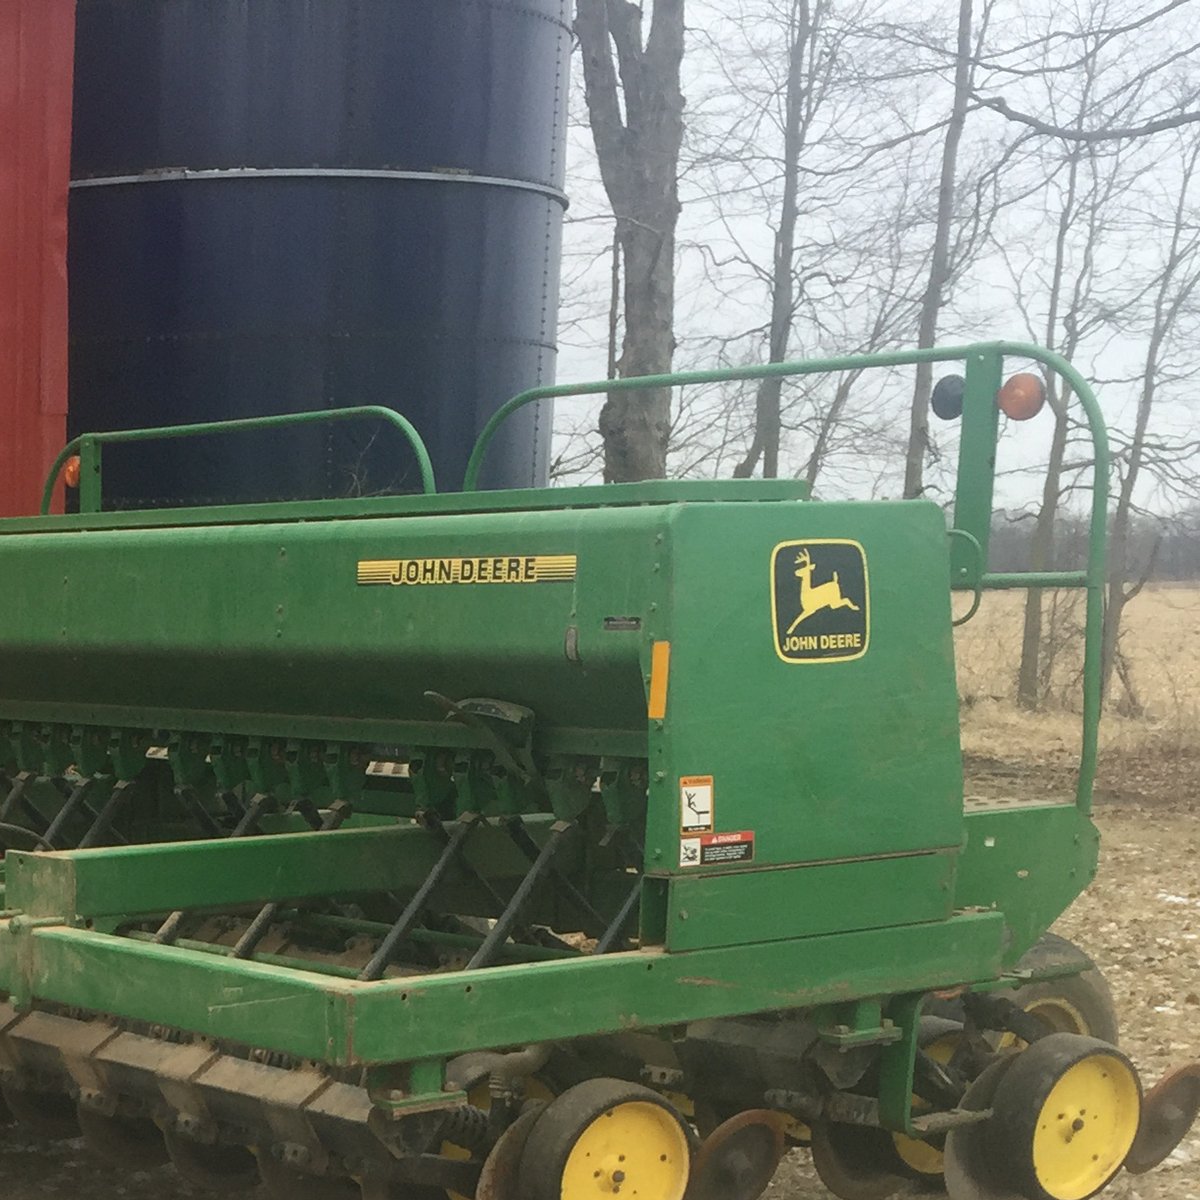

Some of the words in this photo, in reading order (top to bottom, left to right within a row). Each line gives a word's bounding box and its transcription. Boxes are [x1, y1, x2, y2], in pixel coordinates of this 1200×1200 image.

[392, 560, 452, 583] JOHN
[460, 558, 536, 581] DEERE
[783, 636, 818, 652] JOHN
[820, 633, 861, 649] DEERE
